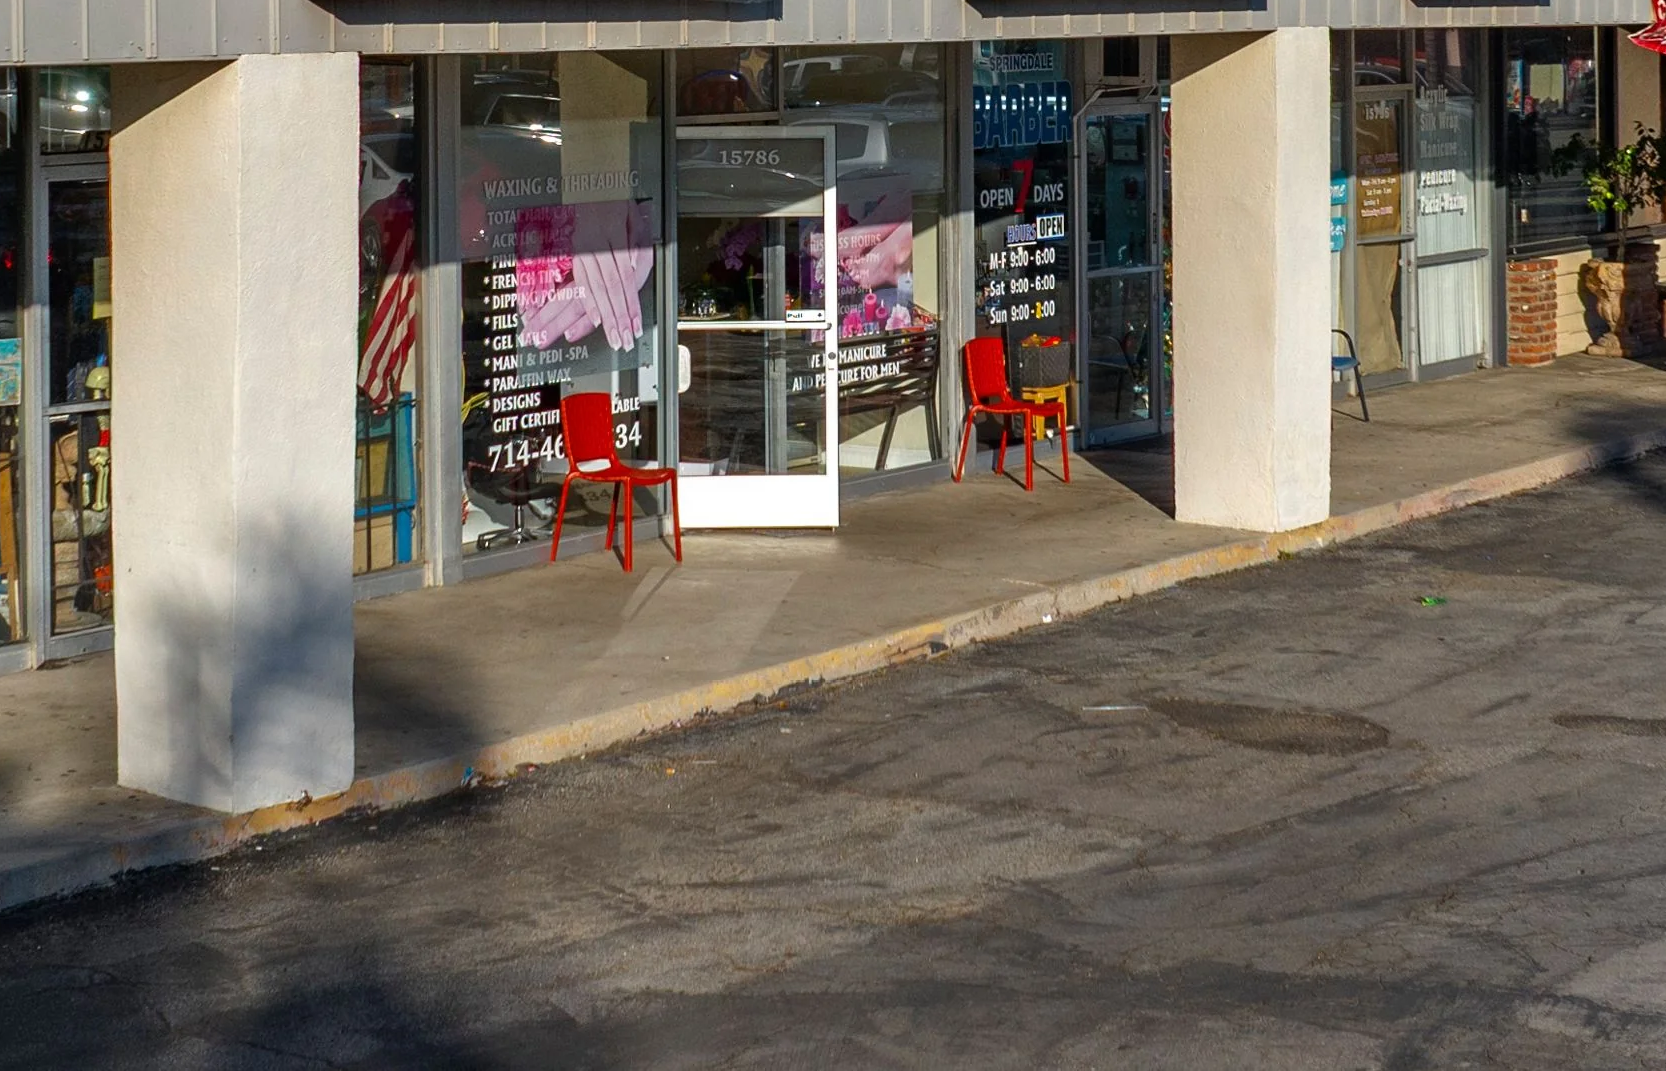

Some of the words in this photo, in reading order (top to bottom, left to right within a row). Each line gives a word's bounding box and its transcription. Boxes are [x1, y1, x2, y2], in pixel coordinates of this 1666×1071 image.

[989, 52, 1054, 73] SPRINGDALE
[973, 80, 1072, 150] BARBER
[719, 149, 781, 166] 15786
[1419, 139, 1458, 158] Manicure
[484, 177, 542, 199] WAXING
[546, 176, 559, 194] &
[563, 170, 640, 193] THREADING
[979, 186, 1014, 209] OPEN
[1011, 159, 1034, 214] 7
[1033, 182, 1064, 204] DAYS
[1007, 222, 1037, 244] HOURS
[1039, 216, 1064, 237] OPEN
[851, 233, 882, 249] HOURS
[989, 251, 1007, 270] M-F
[1010, 249, 1029, 268] 9:00
[1035, 247, 1056, 266] 6:00
[492, 272, 535, 290] FRENCH
[539, 268, 563, 284] TIPS
[989, 280, 1006, 297] Sat
[1010, 277, 1029, 295] 9:00
[1035, 274, 1056, 291] 6:00
[492, 290, 539, 311] DIPPING
[540, 286, 587, 307] POWDER
[492, 313, 520, 331] FILLS
[989, 307, 1007, 325] Sun
[1011, 303, 1030, 321] 9:00
[492, 334, 514, 351] GEL
[492, 355, 524, 373] MANI
[526, 352, 537, 368] &
[539, 348, 563, 365] PEDI
[838, 344, 887, 364] MANICURE
[492, 373, 545, 393] PARAFFIN
[546, 367, 572, 384] WAX
[815, 366, 860, 389] PECURE
[860, 365, 879, 381] FOR
[880, 360, 901, 377] MEN
[492, 392, 542, 414] DESIGNS
[493, 416, 518, 433] GIFT
[520, 409, 561, 429] CERTIFI
